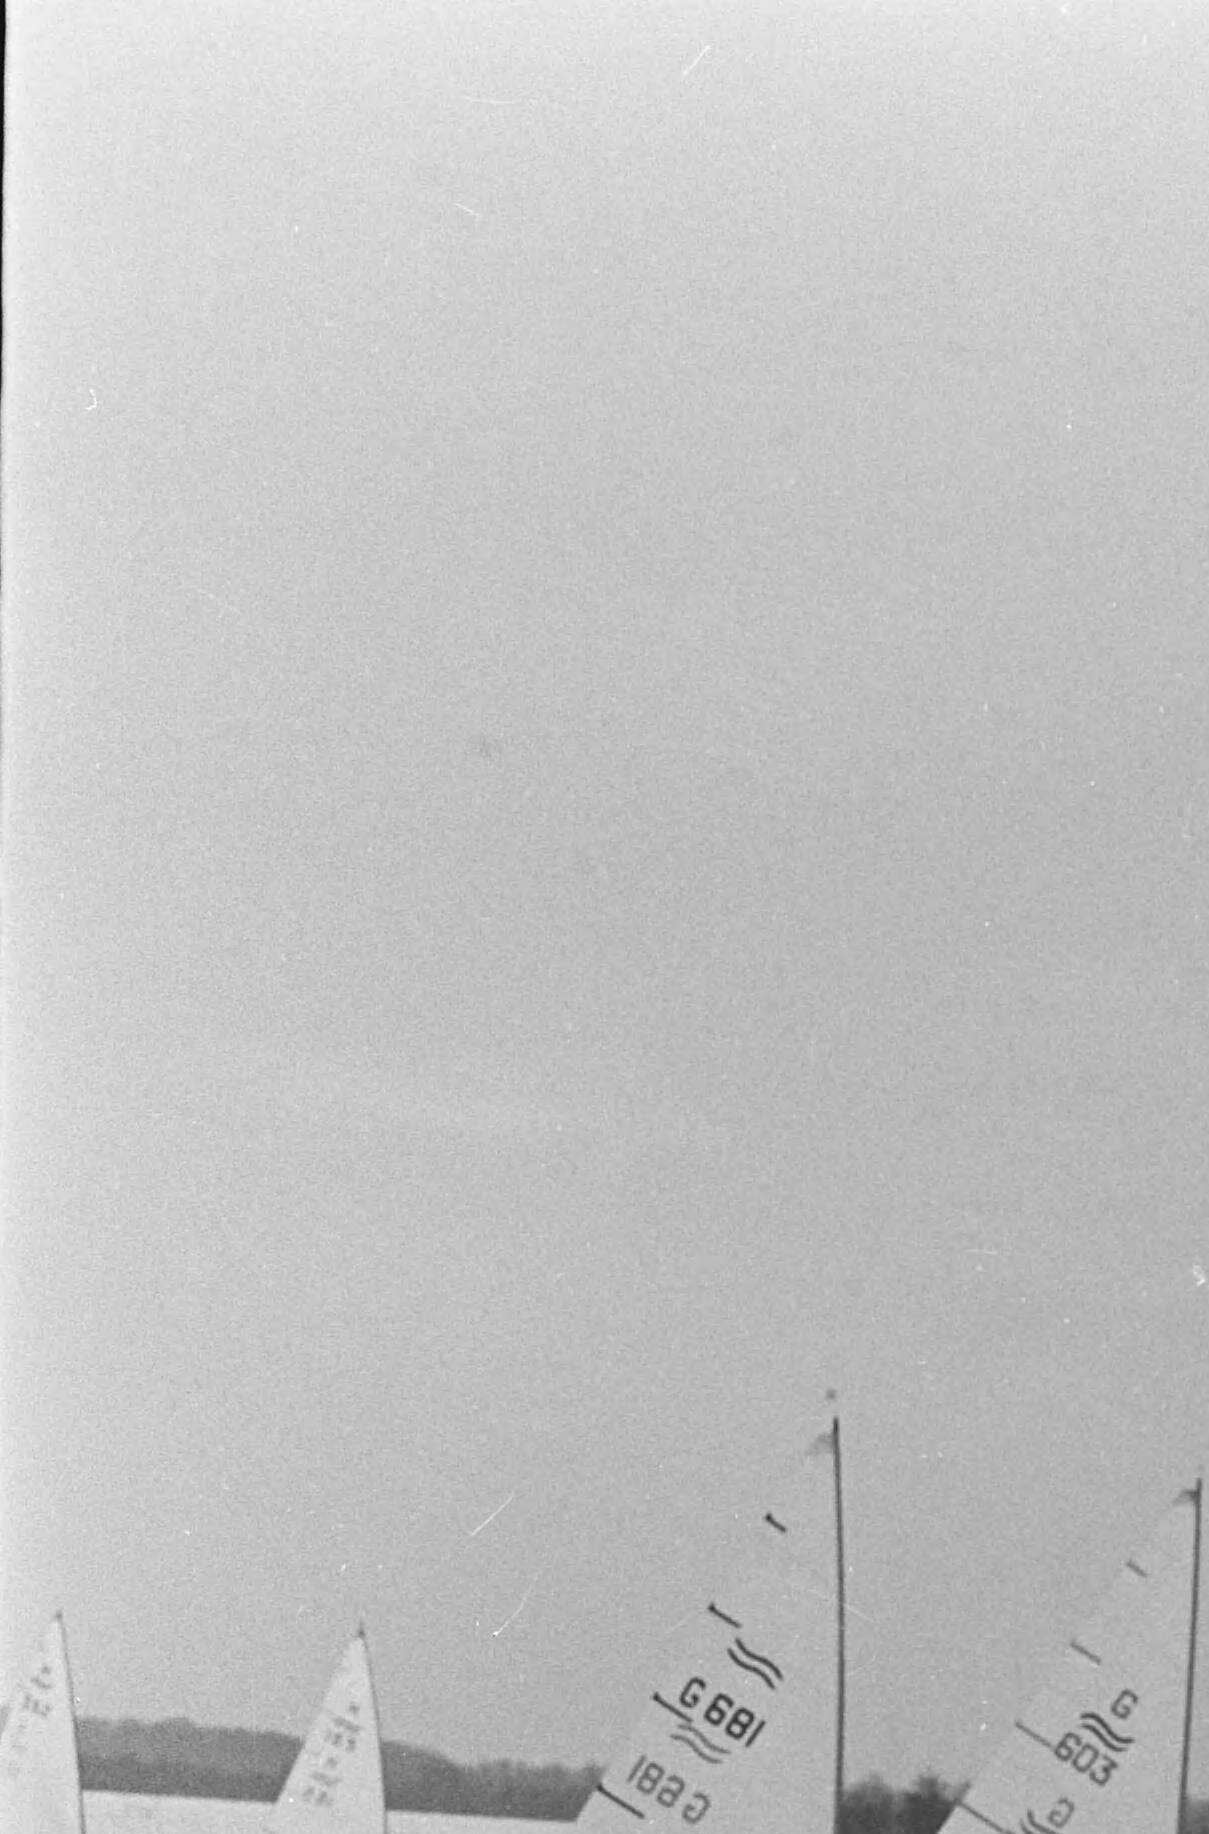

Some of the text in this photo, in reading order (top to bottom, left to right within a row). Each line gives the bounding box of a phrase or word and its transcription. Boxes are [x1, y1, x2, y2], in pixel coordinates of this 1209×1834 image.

[679, 1676, 766, 1748] G 681
[1110, 1689, 1139, 1720] G
[1054, 1732, 1118, 1786] 603
